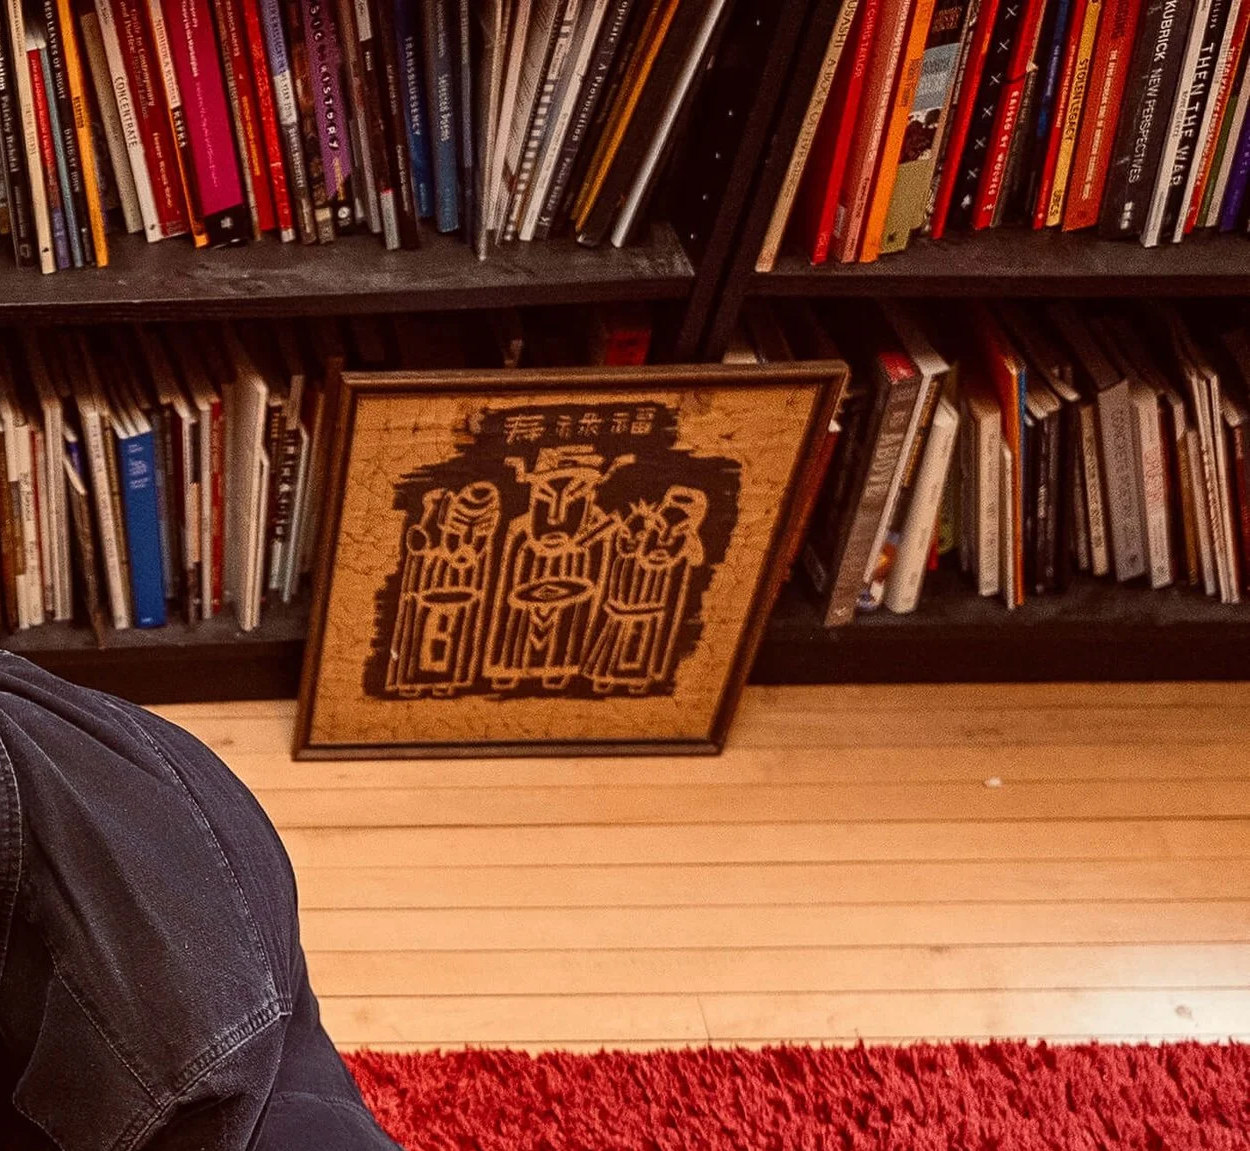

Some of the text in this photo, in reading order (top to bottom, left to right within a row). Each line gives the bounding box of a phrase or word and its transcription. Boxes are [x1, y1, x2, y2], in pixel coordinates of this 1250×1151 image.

[45, 20, 59, 54] LEAVES
[133, 36, 144, 47] to
[307, 4, 326, 41] SIC
[833, 0, 857, 50] USASHI
[51, 57, 62, 69] OF
[53, 71, 67, 100] NIGHT
[134, 47, 157, 107] Contemporary
[403, 36, 422, 137] TRANSBLUESENCY
[1070, 56, 1090, 100] STOLEN
[113, 75, 138, 148] CONCENTRATE
[569, 73, 602, 143] Provocation
[1124, 0, 1178, 185] KUBRICK NEW PERSPECTIVES
[1168, 40, 1214, 187] THEN THE WAR
[171, 110, 187, 148] KAFKA
[1061, 99, 1081, 142] LEGACY
[62, 128, 81, 193] DAVID JOHN
